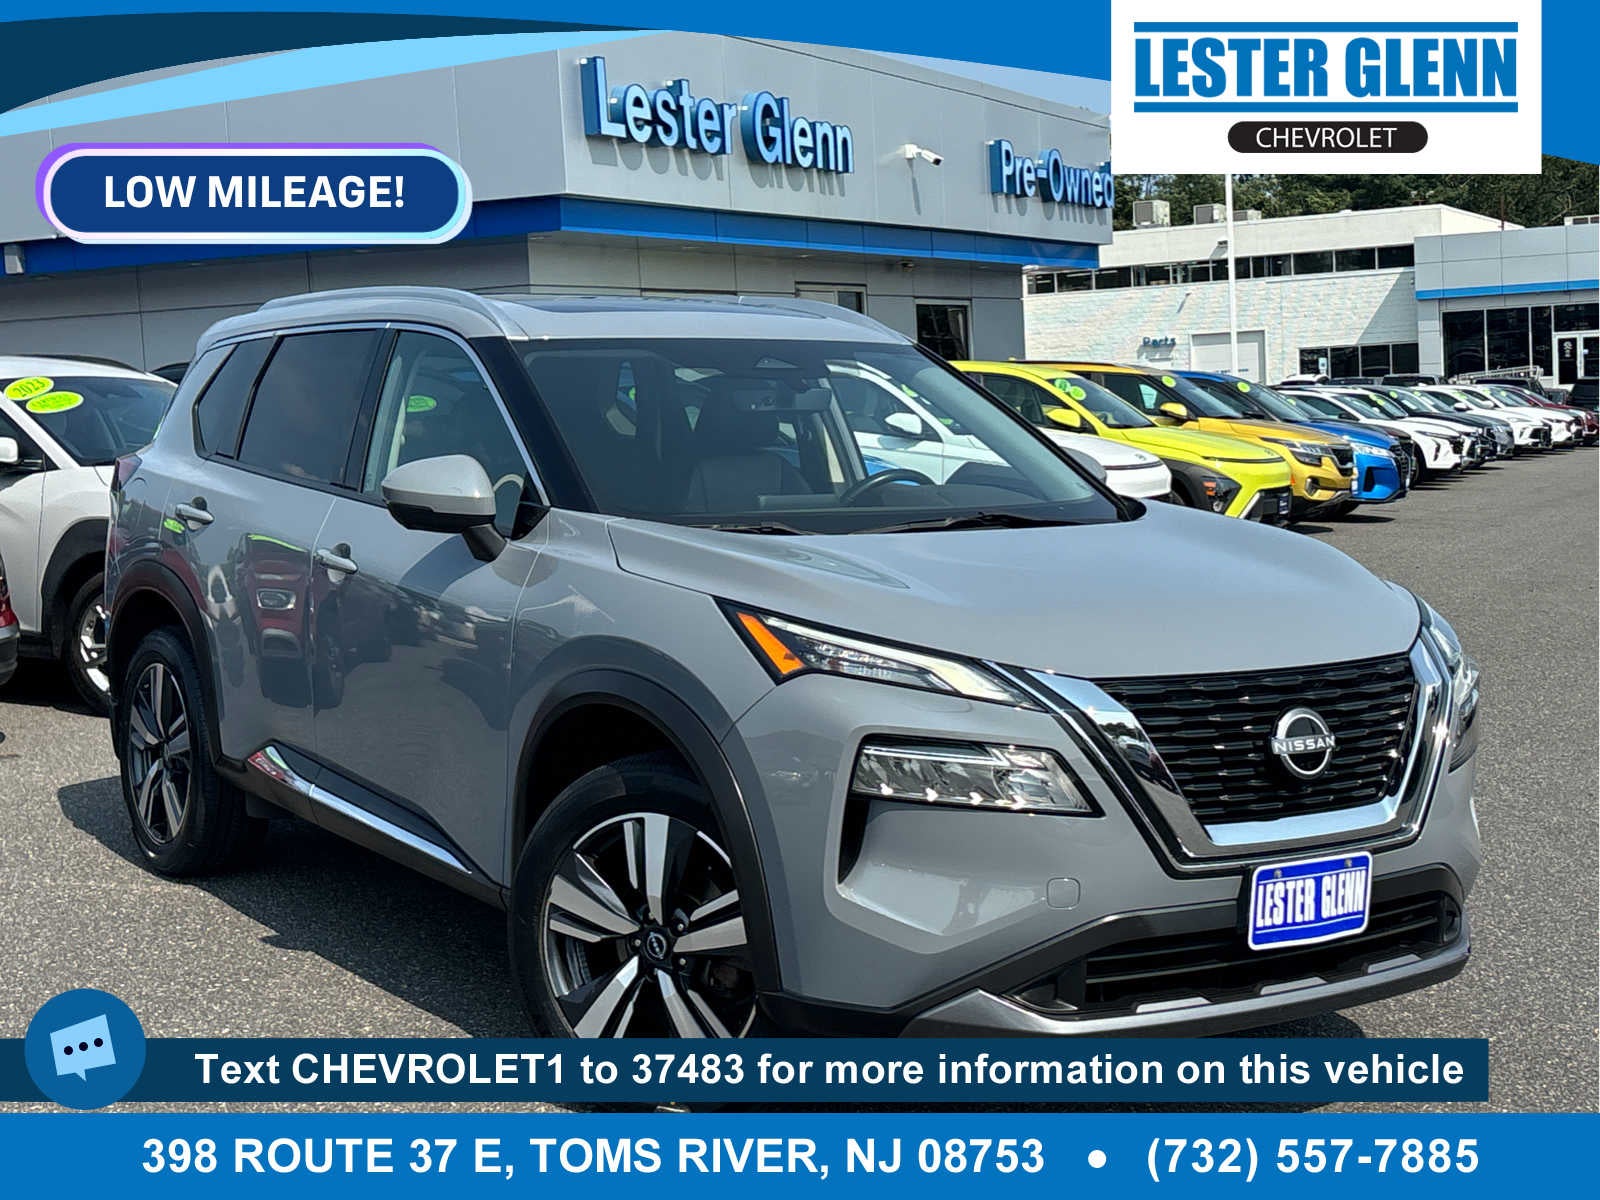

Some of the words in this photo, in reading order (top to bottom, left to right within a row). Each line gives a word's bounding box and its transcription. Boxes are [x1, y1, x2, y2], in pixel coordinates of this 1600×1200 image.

[581, 56, 738, 156] Lester
[741, 90, 855, 175] Glenn
[989, 139, 1115, 208] Pre-Owned
[1273, 736, 1336, 754] NISSAN
[1256, 877, 1317, 928] LESTER
[1320, 869, 1367, 919] GLENN
